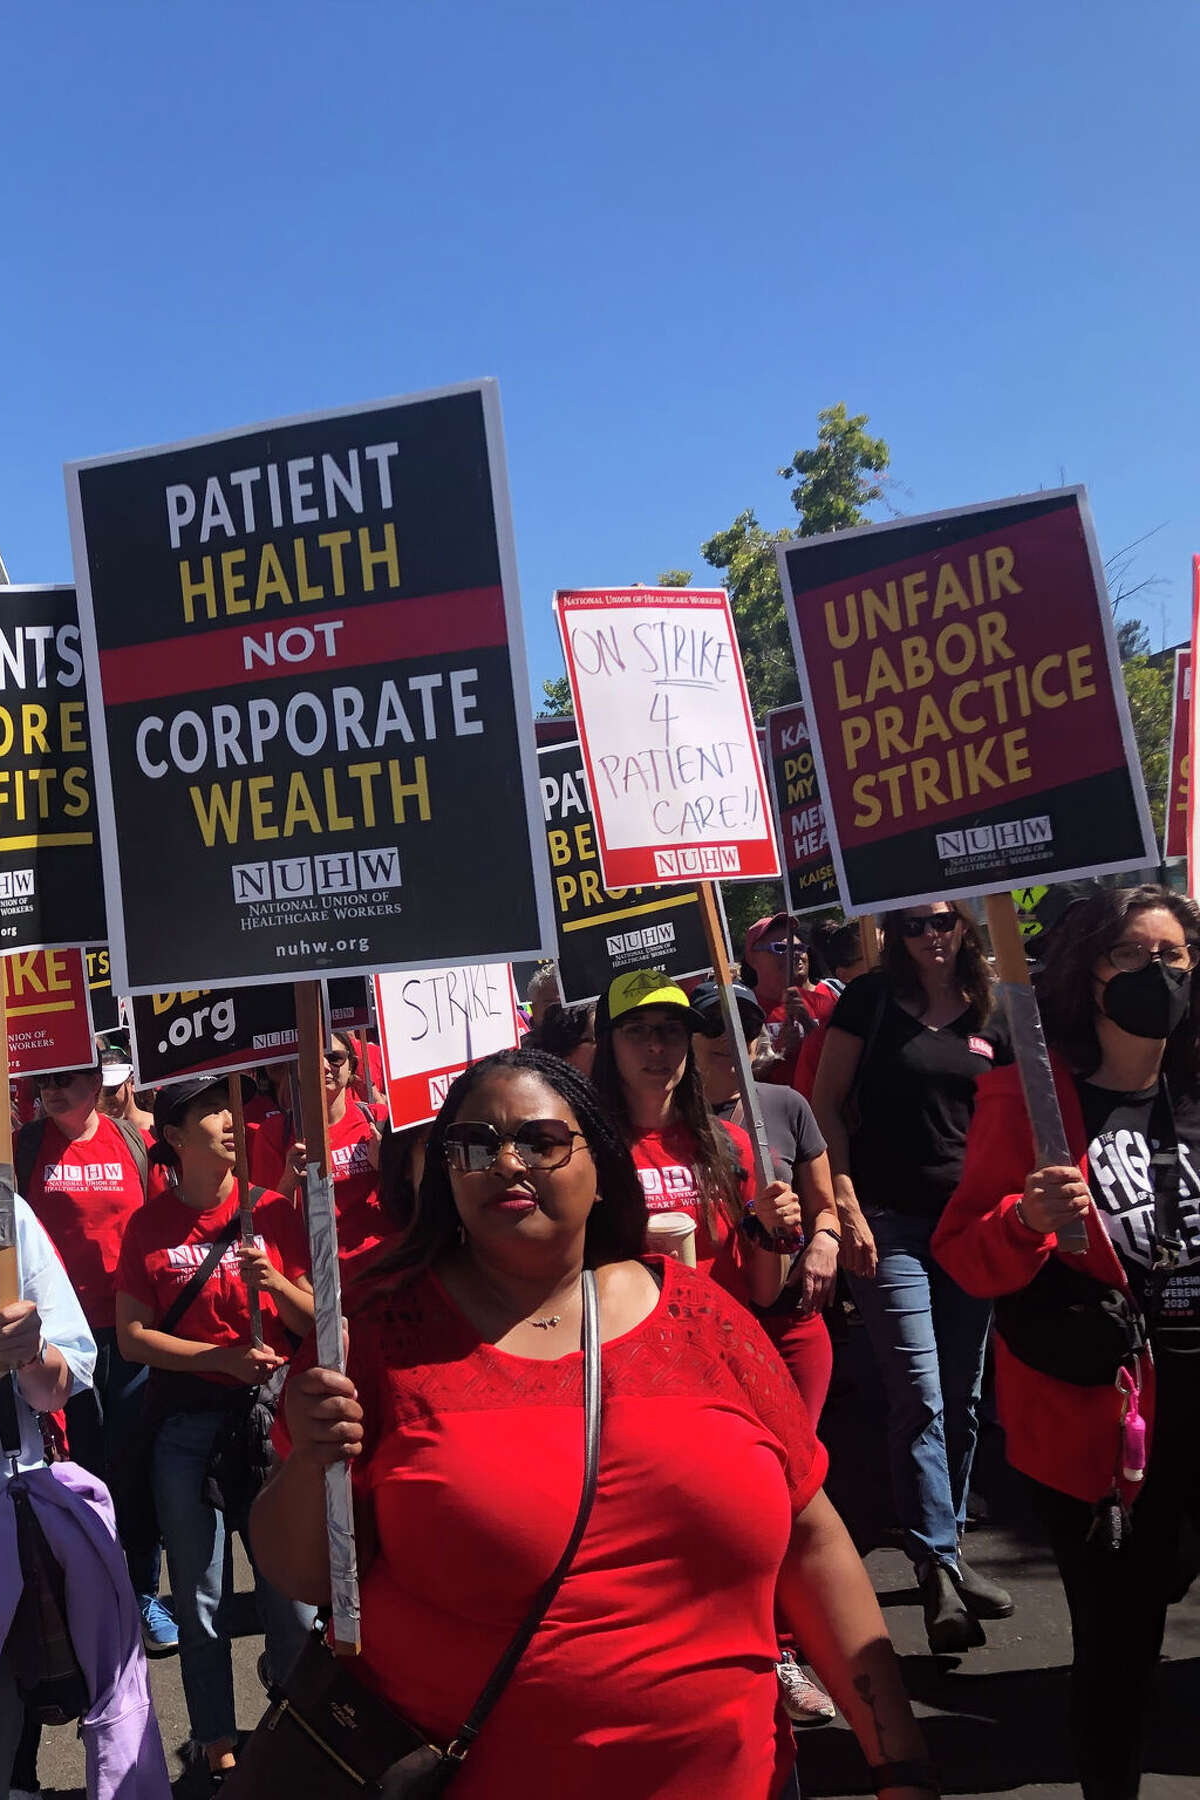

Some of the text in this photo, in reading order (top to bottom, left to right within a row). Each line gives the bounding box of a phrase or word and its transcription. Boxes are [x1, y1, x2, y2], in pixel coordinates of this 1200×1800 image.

[165, 441, 399, 549] PATIENT
[180, 522, 401, 623] HEALTH
[823, 545, 1024, 650] UNFAIR
[242, 621, 344, 670] NOT
[571, 622, 732, 683] ON STRIKE
[833, 611, 1015, 711] LABOR
[135, 668, 484, 779] CORPORATE
[649, 693, 679, 747] 4
[840, 643, 1096, 770] PRACTICE
[598, 742, 745, 799] PATIENT
[787, 774, 815, 804] MY
[851, 728, 1033, 829] STRIKE
[189, 756, 432, 847] WEALTH
[794, 831, 830, 860] HEA
[938, 817, 1051, 857] NUHW
[234, 849, 400, 901] NUHW
[655, 846, 740, 876] NUHW
[799, 864, 834, 889] KAISE
[0, 905, 34, 917] WORKERS
[18, 897, 29, 905] OF
[240, 903, 402, 931] HEALTHCARE WORKERS
[249, 891, 390, 917] NATIONAL UNION OF
[275, 937, 370, 957] nuhw.org
[607, 923, 674, 955] NUHW
[402, 965, 502, 1041] STRIKE
[8, 1033, 32, 1043] NION
[34, 1030, 48, 1040] OF
[8, 1038, 55, 1052] WORKERS
[157, 998, 236, 1054] .org
[253, 1030, 298, 1050] NUH
[45, 1164, 122, 1181] NUHW
